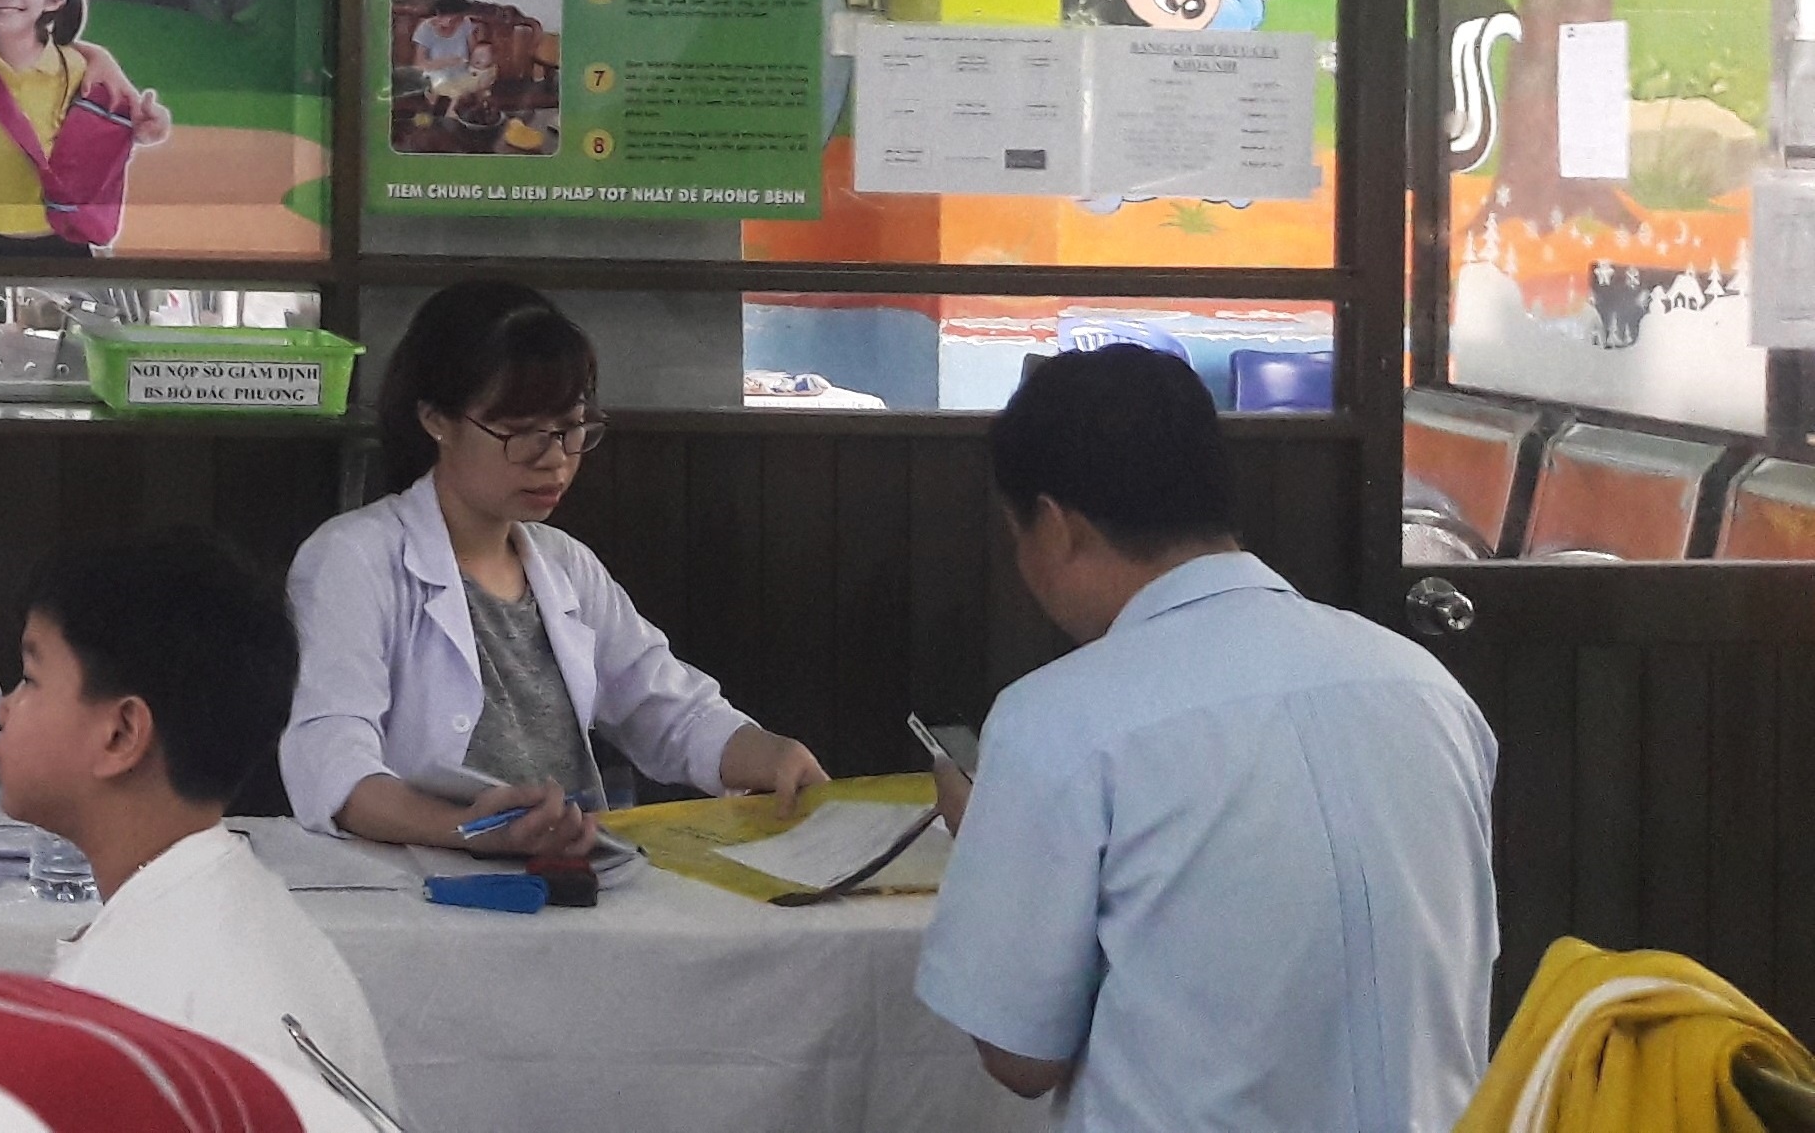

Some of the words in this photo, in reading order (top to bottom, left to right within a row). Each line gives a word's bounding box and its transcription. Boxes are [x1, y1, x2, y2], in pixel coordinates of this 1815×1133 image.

[594, 71, 605, 87] 7
[593, 137, 604, 154] 8
[144, 387, 163, 398] BS
